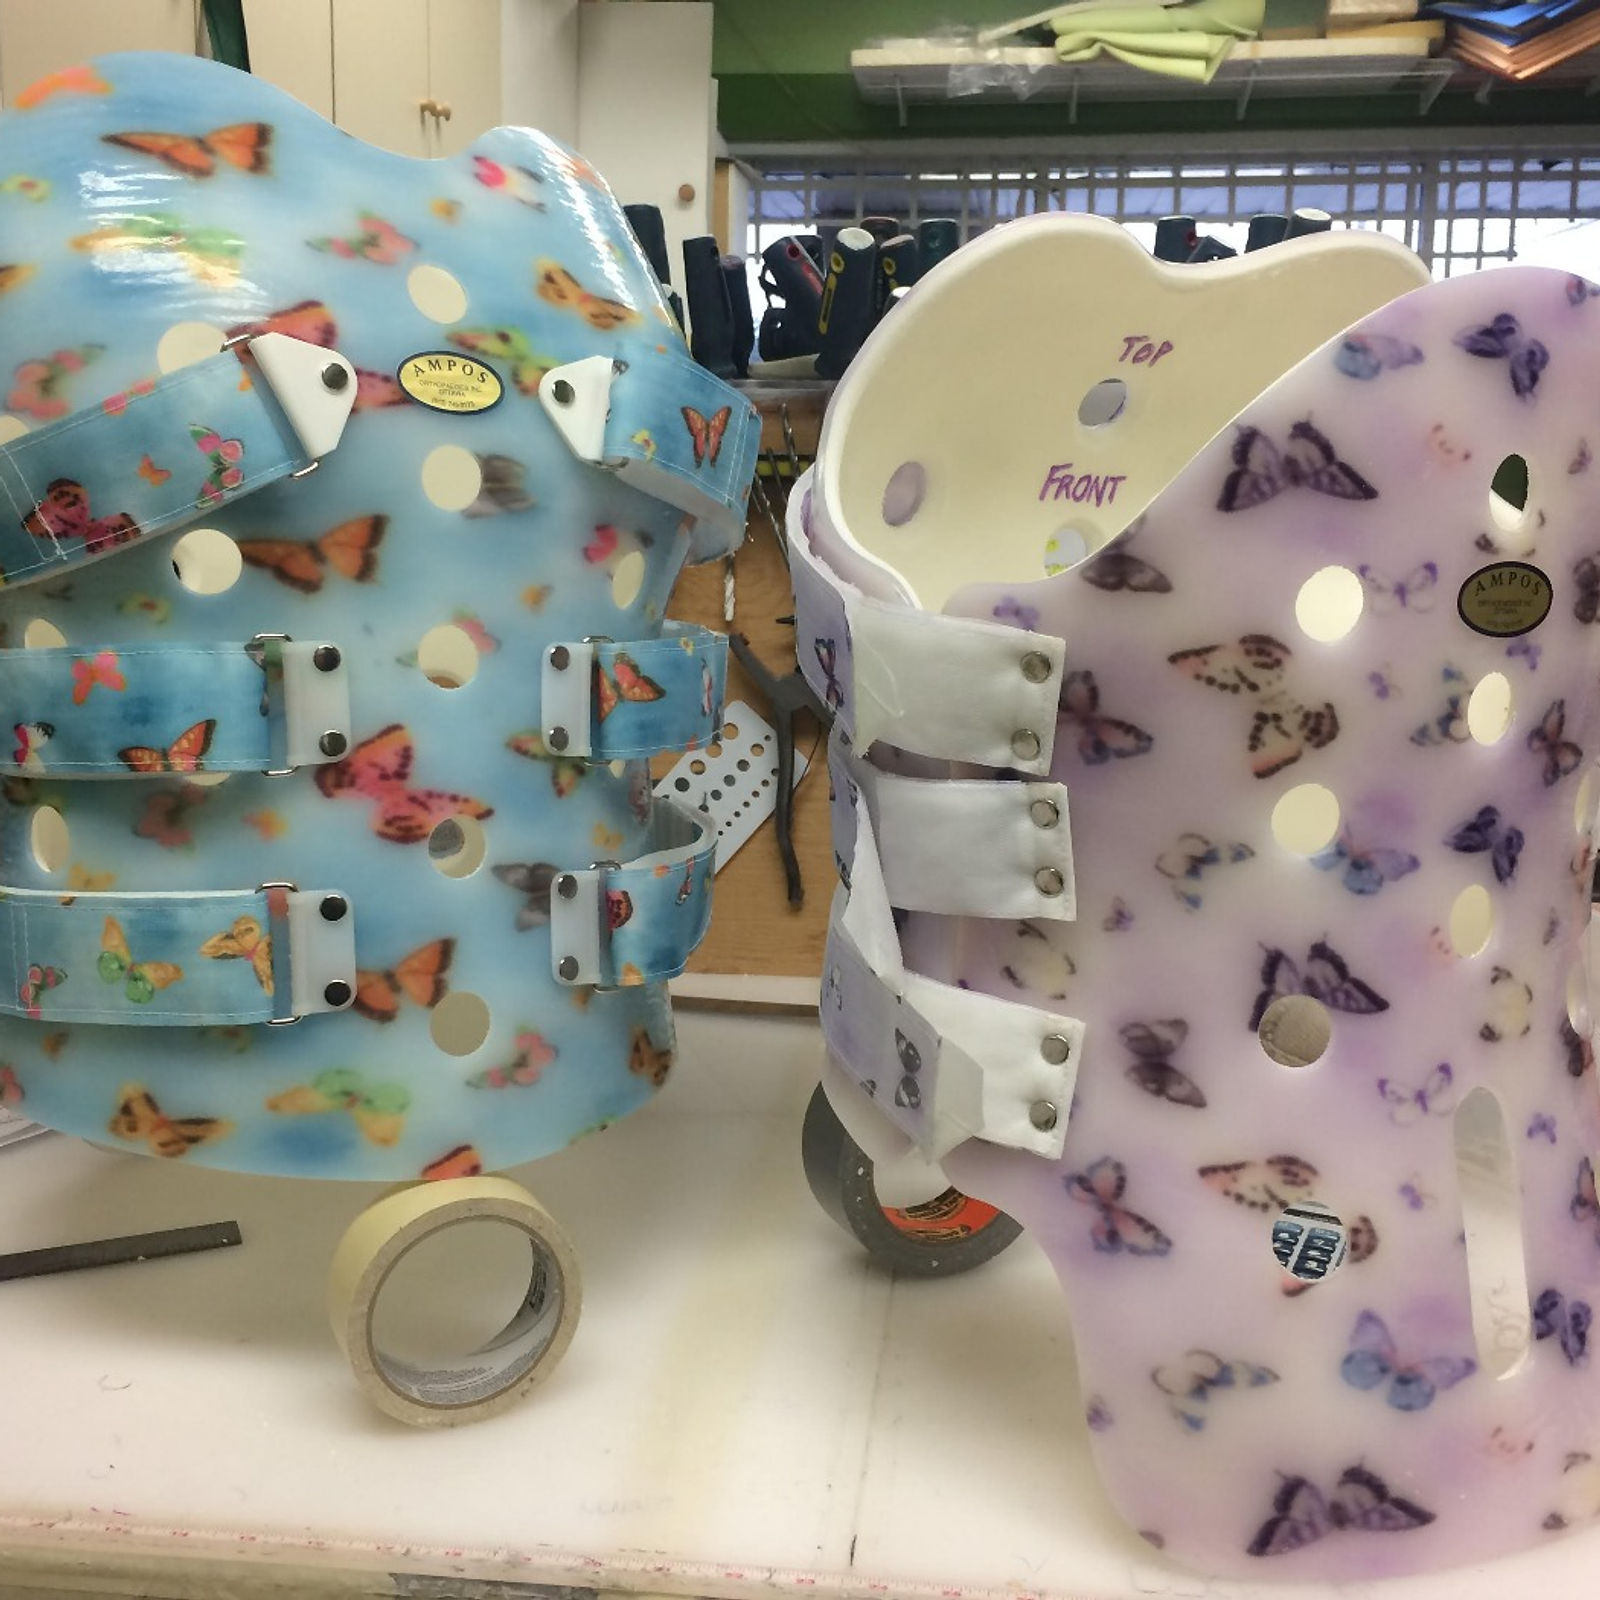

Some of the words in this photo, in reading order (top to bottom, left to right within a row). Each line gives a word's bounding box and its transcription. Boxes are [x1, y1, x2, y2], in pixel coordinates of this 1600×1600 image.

[1118, 335, 1174, 368] TOP
[413, 359, 489, 384] AMPOS
[1038, 462, 1128, 508] FRONT
[1474, 571, 1543, 597] AMPOS
